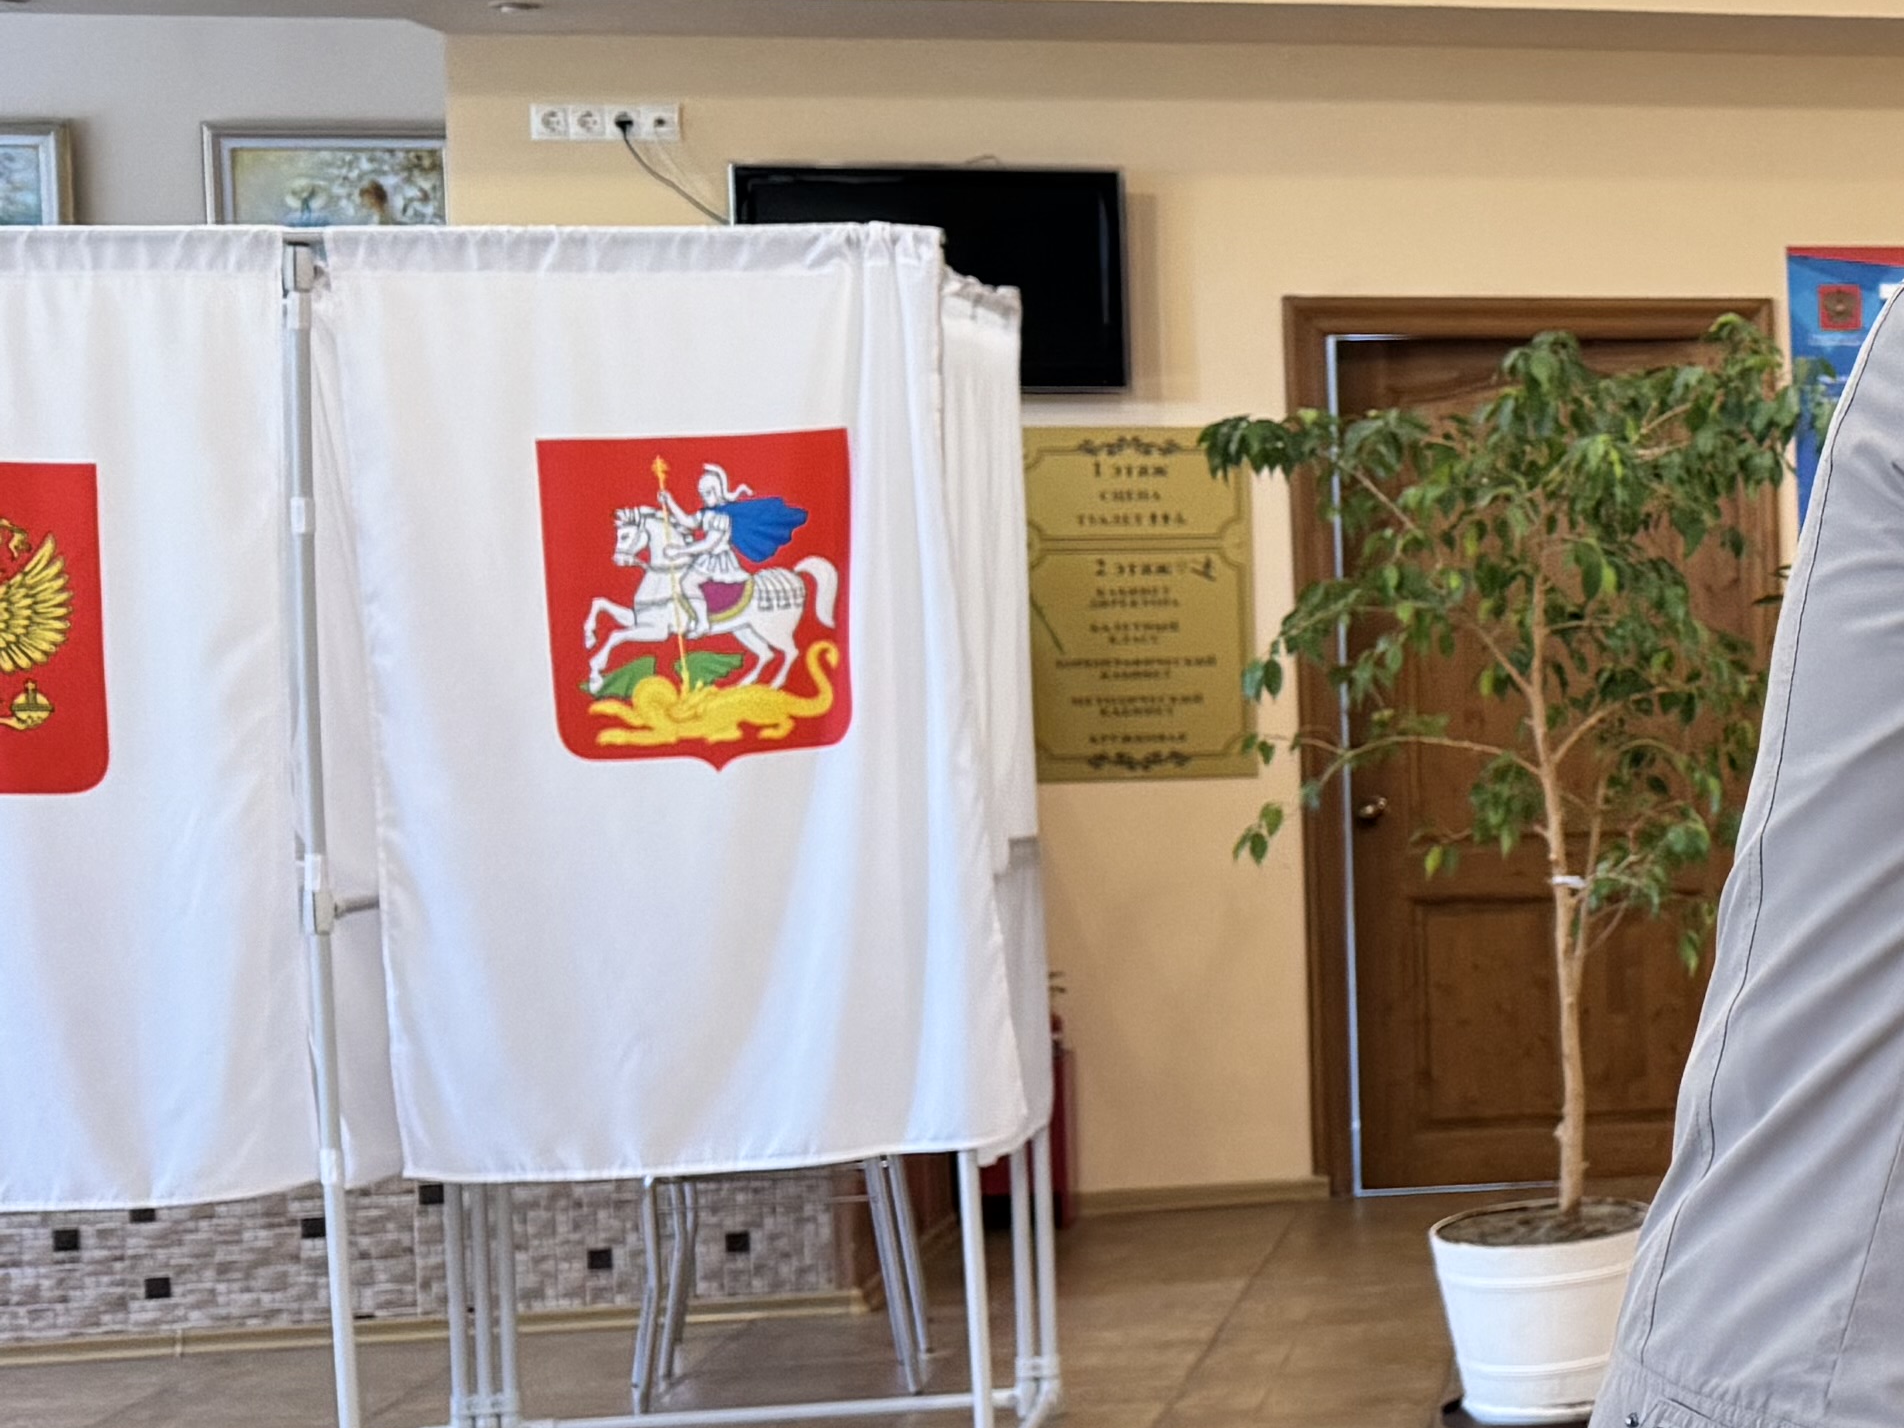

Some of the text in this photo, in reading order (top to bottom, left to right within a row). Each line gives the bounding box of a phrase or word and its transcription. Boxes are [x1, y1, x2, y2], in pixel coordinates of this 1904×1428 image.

[1112, 463, 1168, 478] этаж
[1095, 557, 1172, 577] 2 этаж
